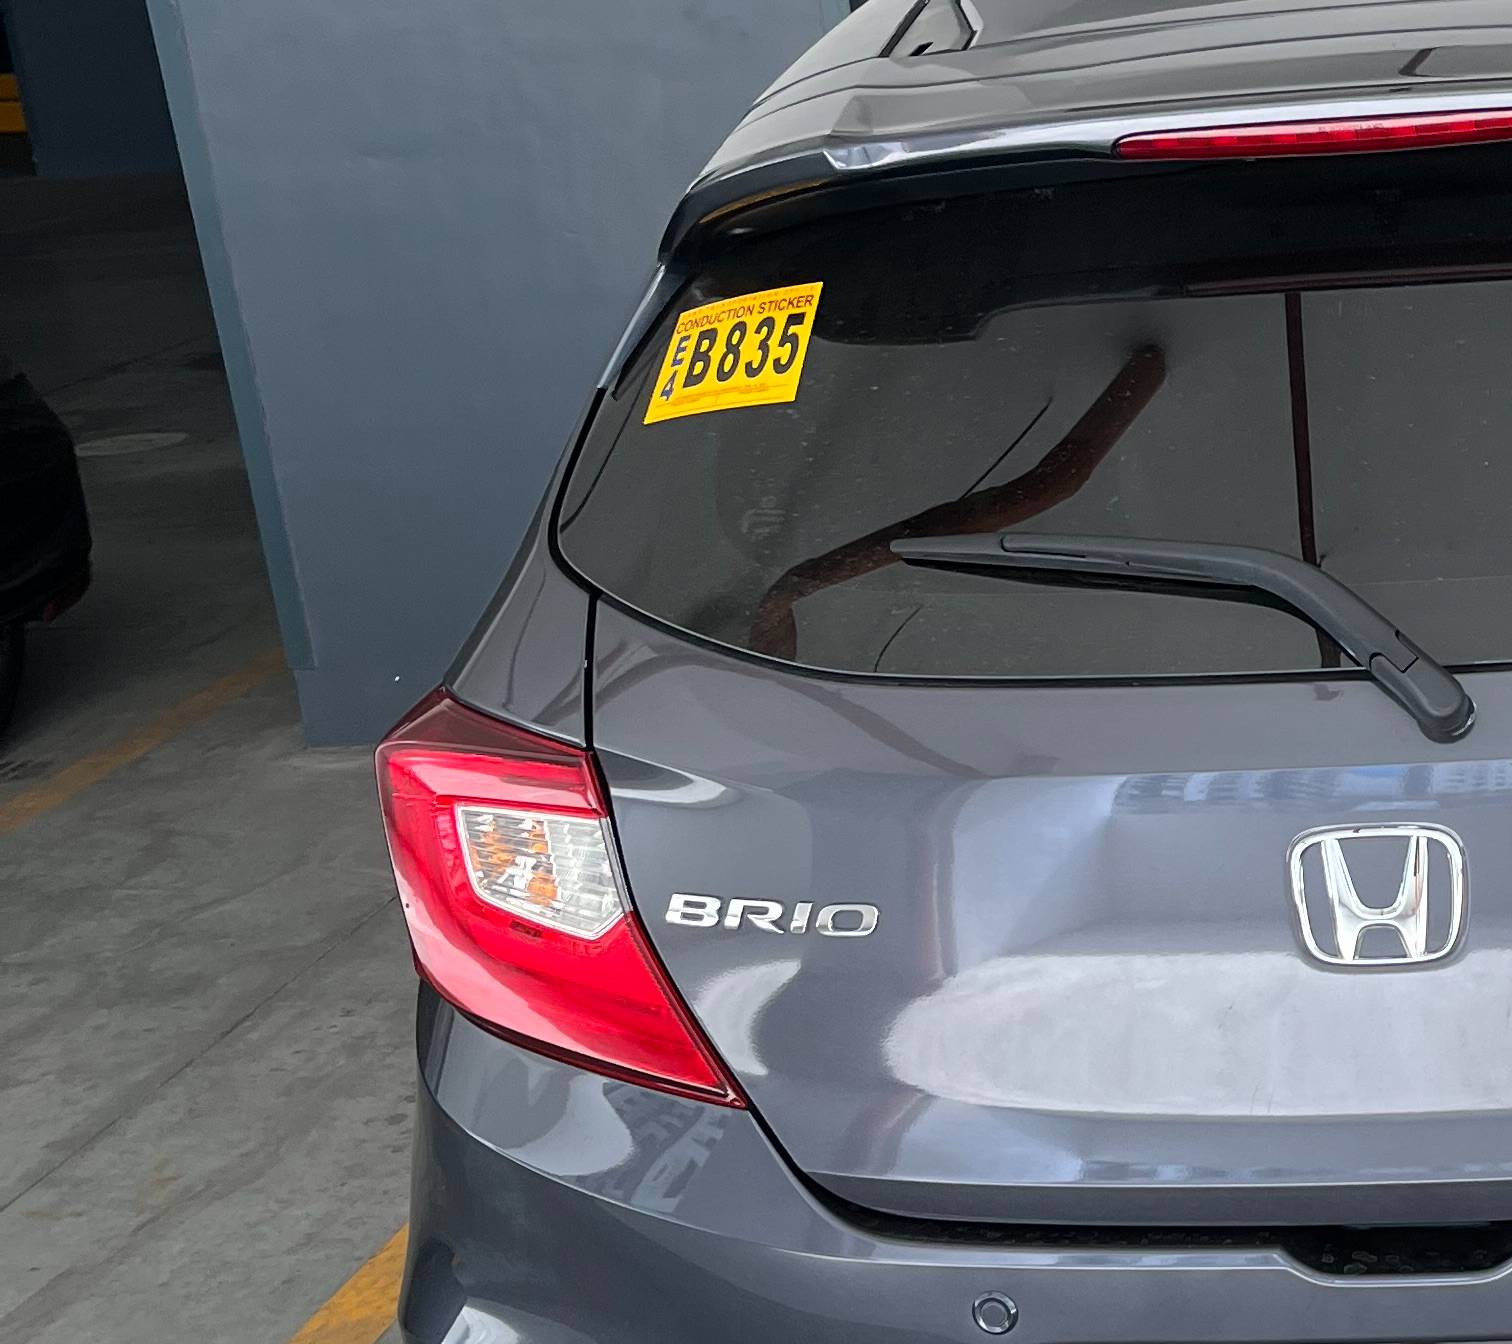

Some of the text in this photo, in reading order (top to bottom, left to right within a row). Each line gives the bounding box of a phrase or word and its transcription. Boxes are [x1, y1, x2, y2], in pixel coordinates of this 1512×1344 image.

[676, 304, 755, 335] CONDUCTION
[758, 294, 814, 314] STICKER
[683, 312, 806, 388] B835
[665, 892, 880, 938] BRIO
